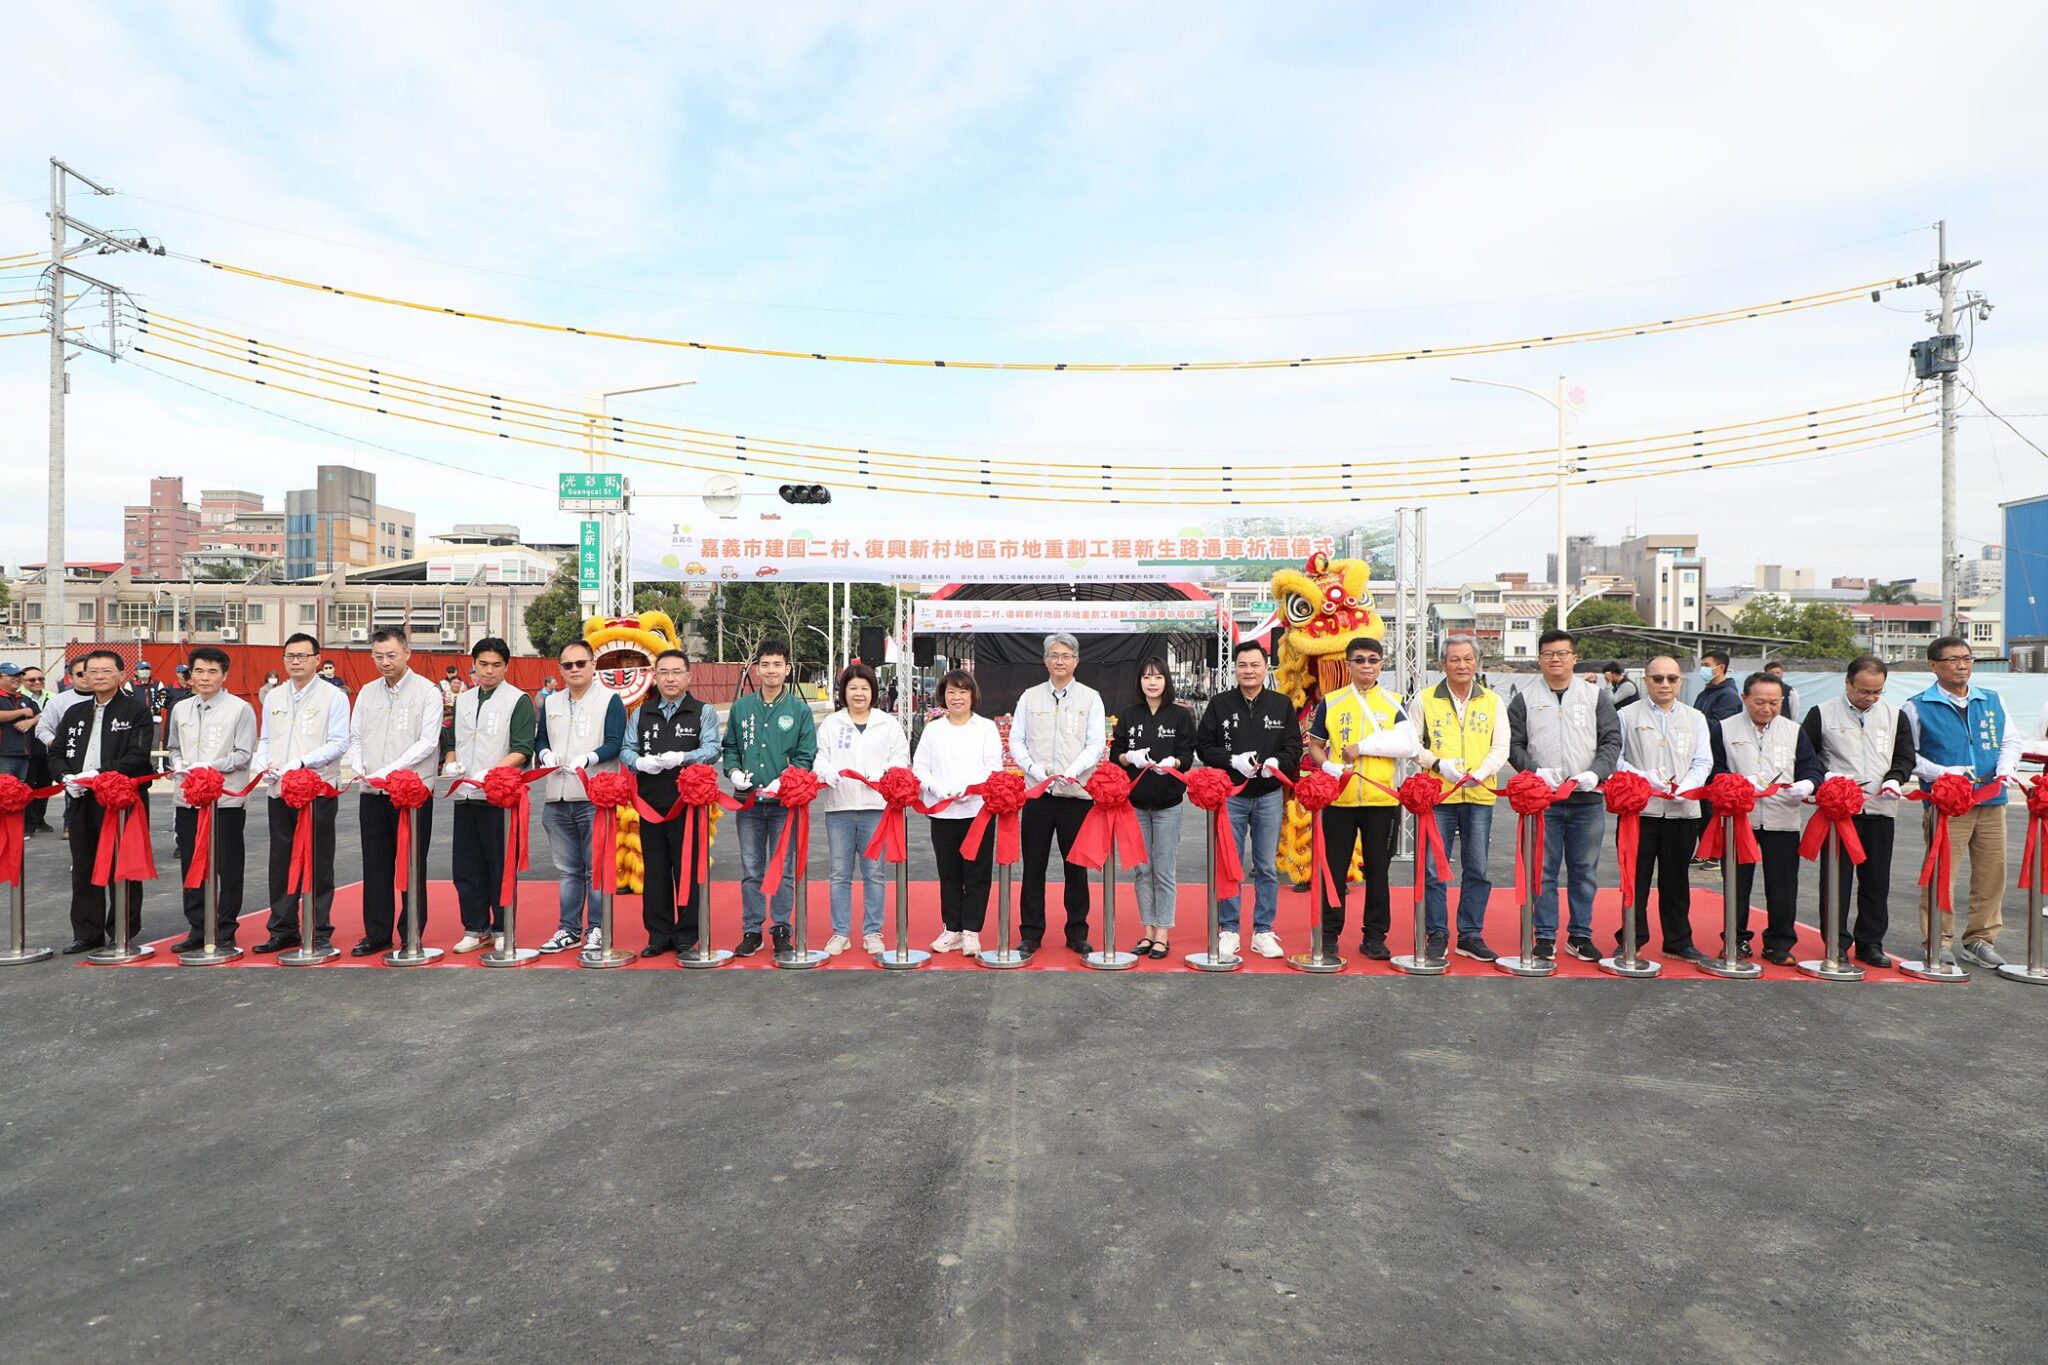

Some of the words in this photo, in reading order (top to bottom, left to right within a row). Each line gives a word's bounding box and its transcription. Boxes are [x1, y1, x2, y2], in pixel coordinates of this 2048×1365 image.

[565, 475, 617, 487] 光彩街
[568, 488, 602, 496] Guangcai
[584, 534, 596, 579] 新生路
[700, 537, 1334, 559] 嘉義市建國二村、復興新村地區市地重劃工程新生路通車祈福儀式
